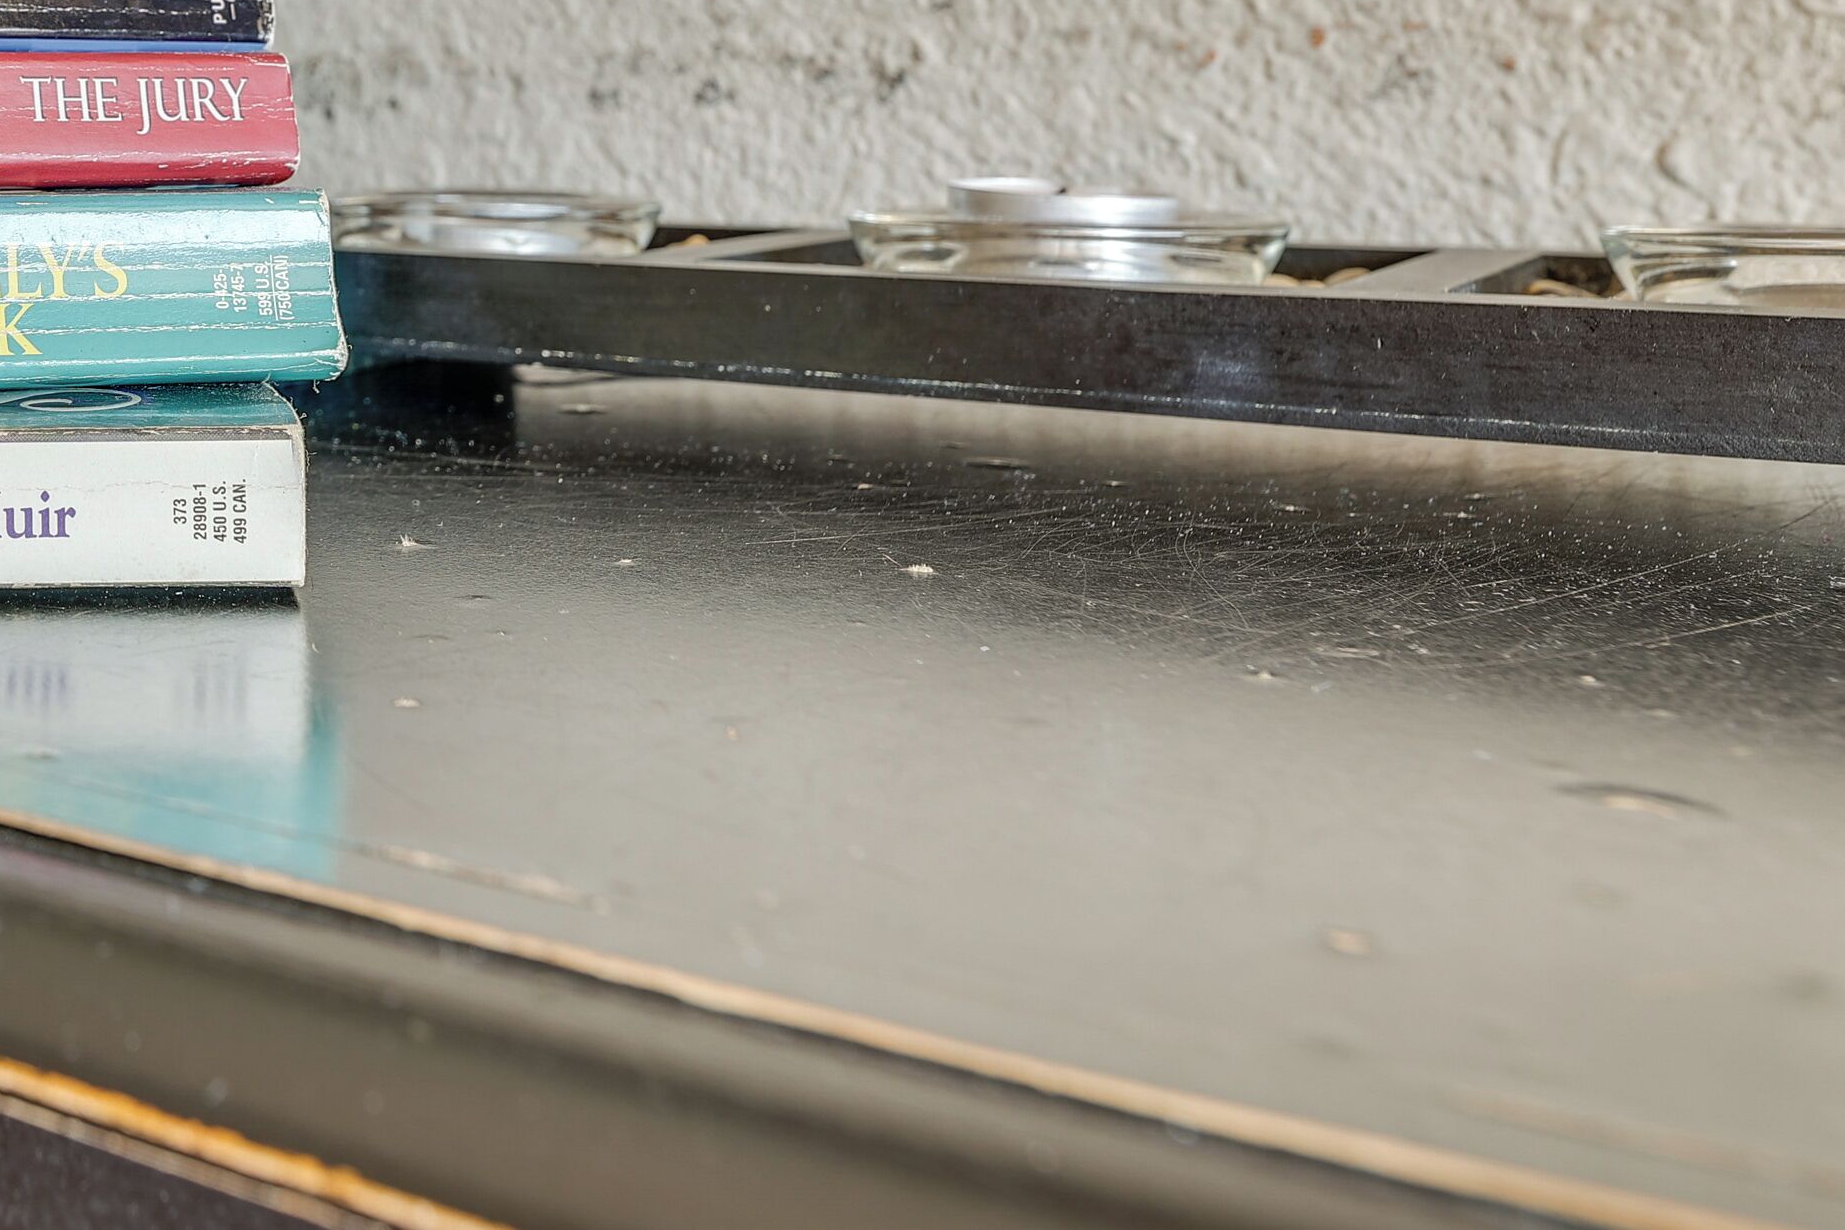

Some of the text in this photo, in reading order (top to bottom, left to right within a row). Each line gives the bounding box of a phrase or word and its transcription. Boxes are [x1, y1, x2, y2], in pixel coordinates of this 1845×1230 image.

[19, 76, 249, 135] THE JURY
[230, 263, 247, 313] 13745-7
[257, 292, 273, 316] 599
[173, 498, 187, 524] 373
[193, 484, 207, 540] 28908-1
[212, 481, 227, 542] 450 U.S.
[232, 478, 247, 544] 499 CAN.
